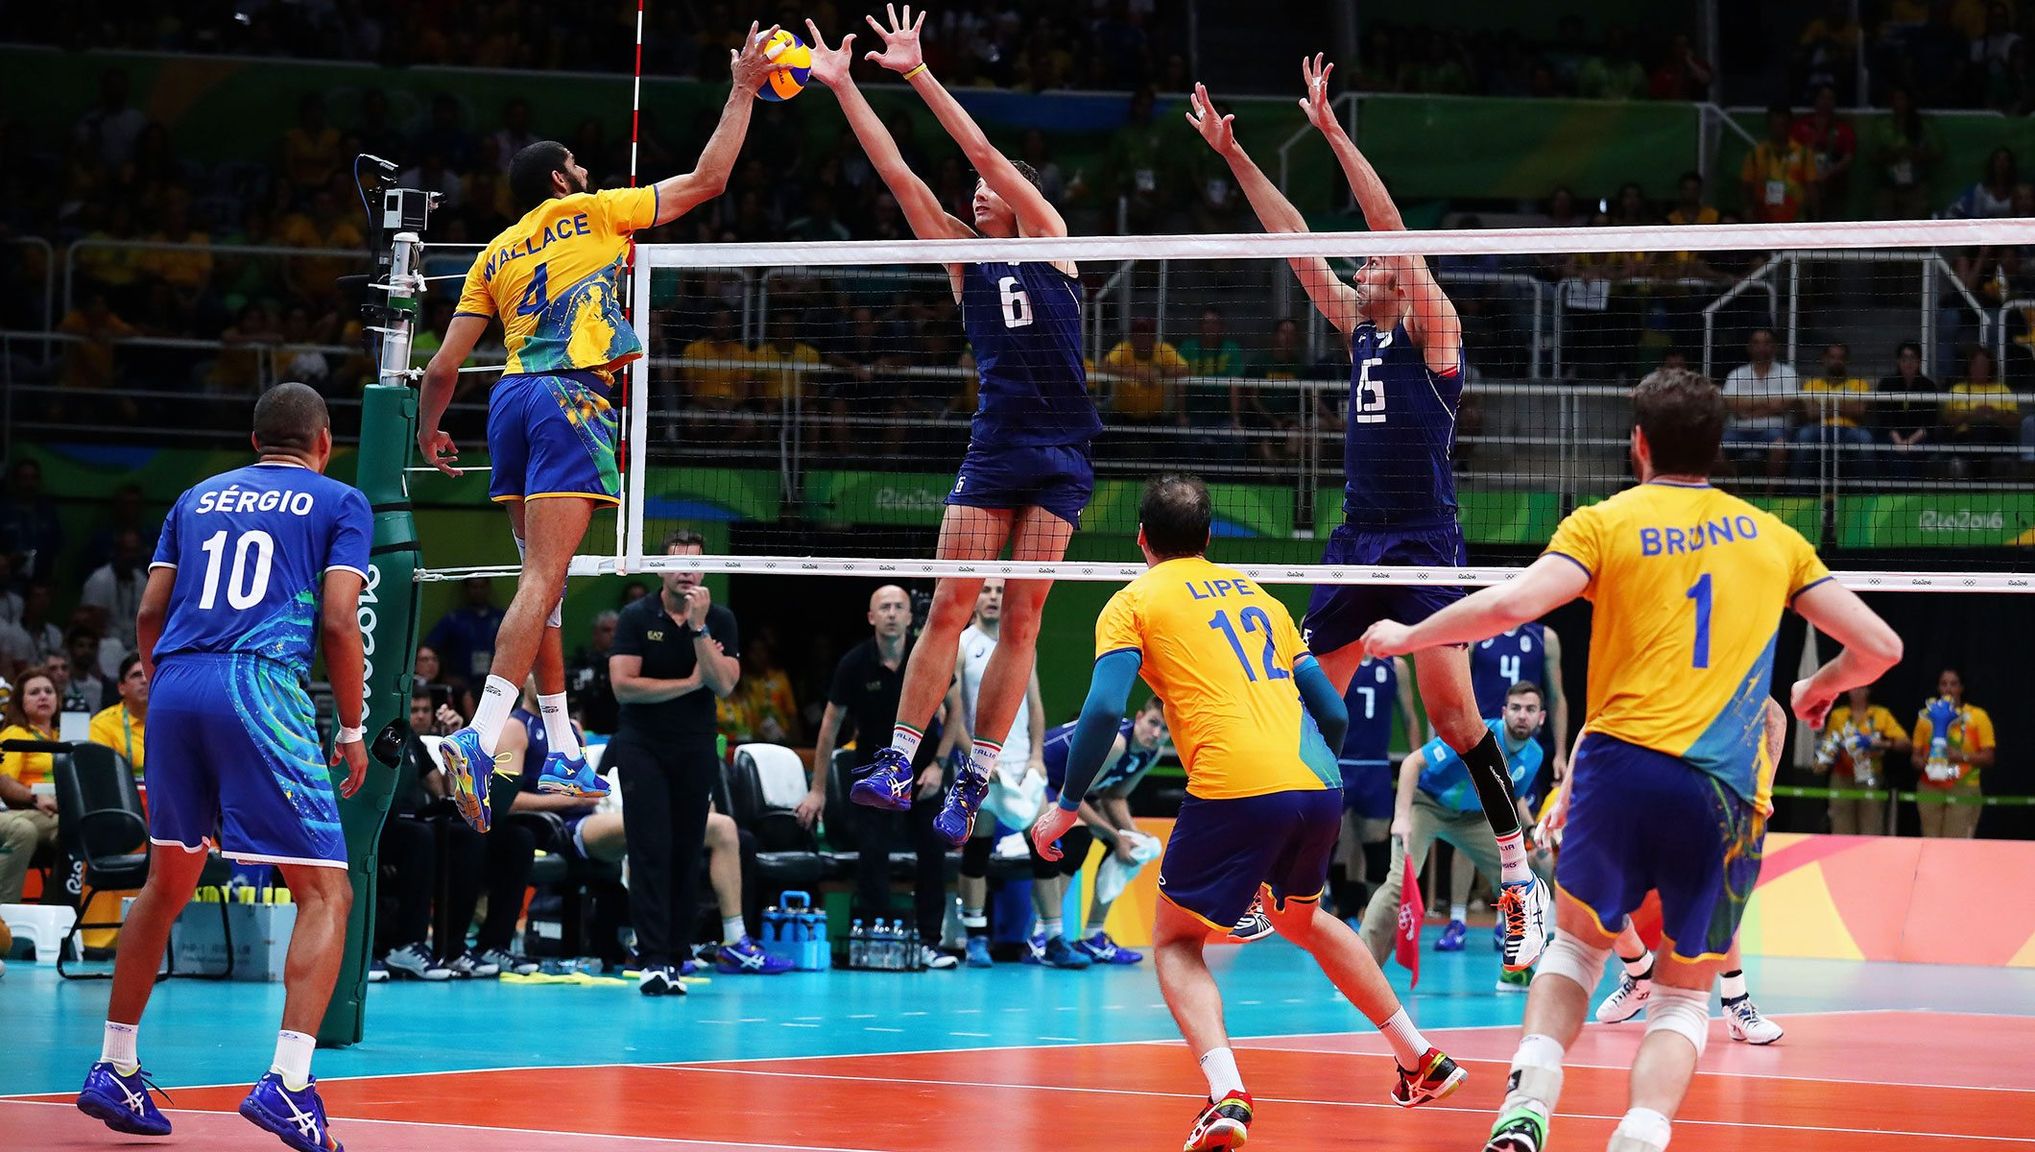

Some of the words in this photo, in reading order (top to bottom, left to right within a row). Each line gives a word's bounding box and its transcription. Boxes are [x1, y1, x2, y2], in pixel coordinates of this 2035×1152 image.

[483, 213, 592, 282] WALLACE
[516, 262, 550, 317] 4
[998, 276, 1033, 329] 6
[1356, 357, 1387, 412] 15
[195, 484, 314, 516] SÉRGIO
[954, 476, 966, 493] 6
[1640, 515, 1758, 557] BRUNO
[198, 529, 275, 611] 10
[1185, 578, 1255, 600] LIPE
[1208, 606, 1290, 682] 12
[1686, 573, 1713, 669] 1
[1500, 654, 1521, 687] 4
[1356, 686, 1375, 719] 7
